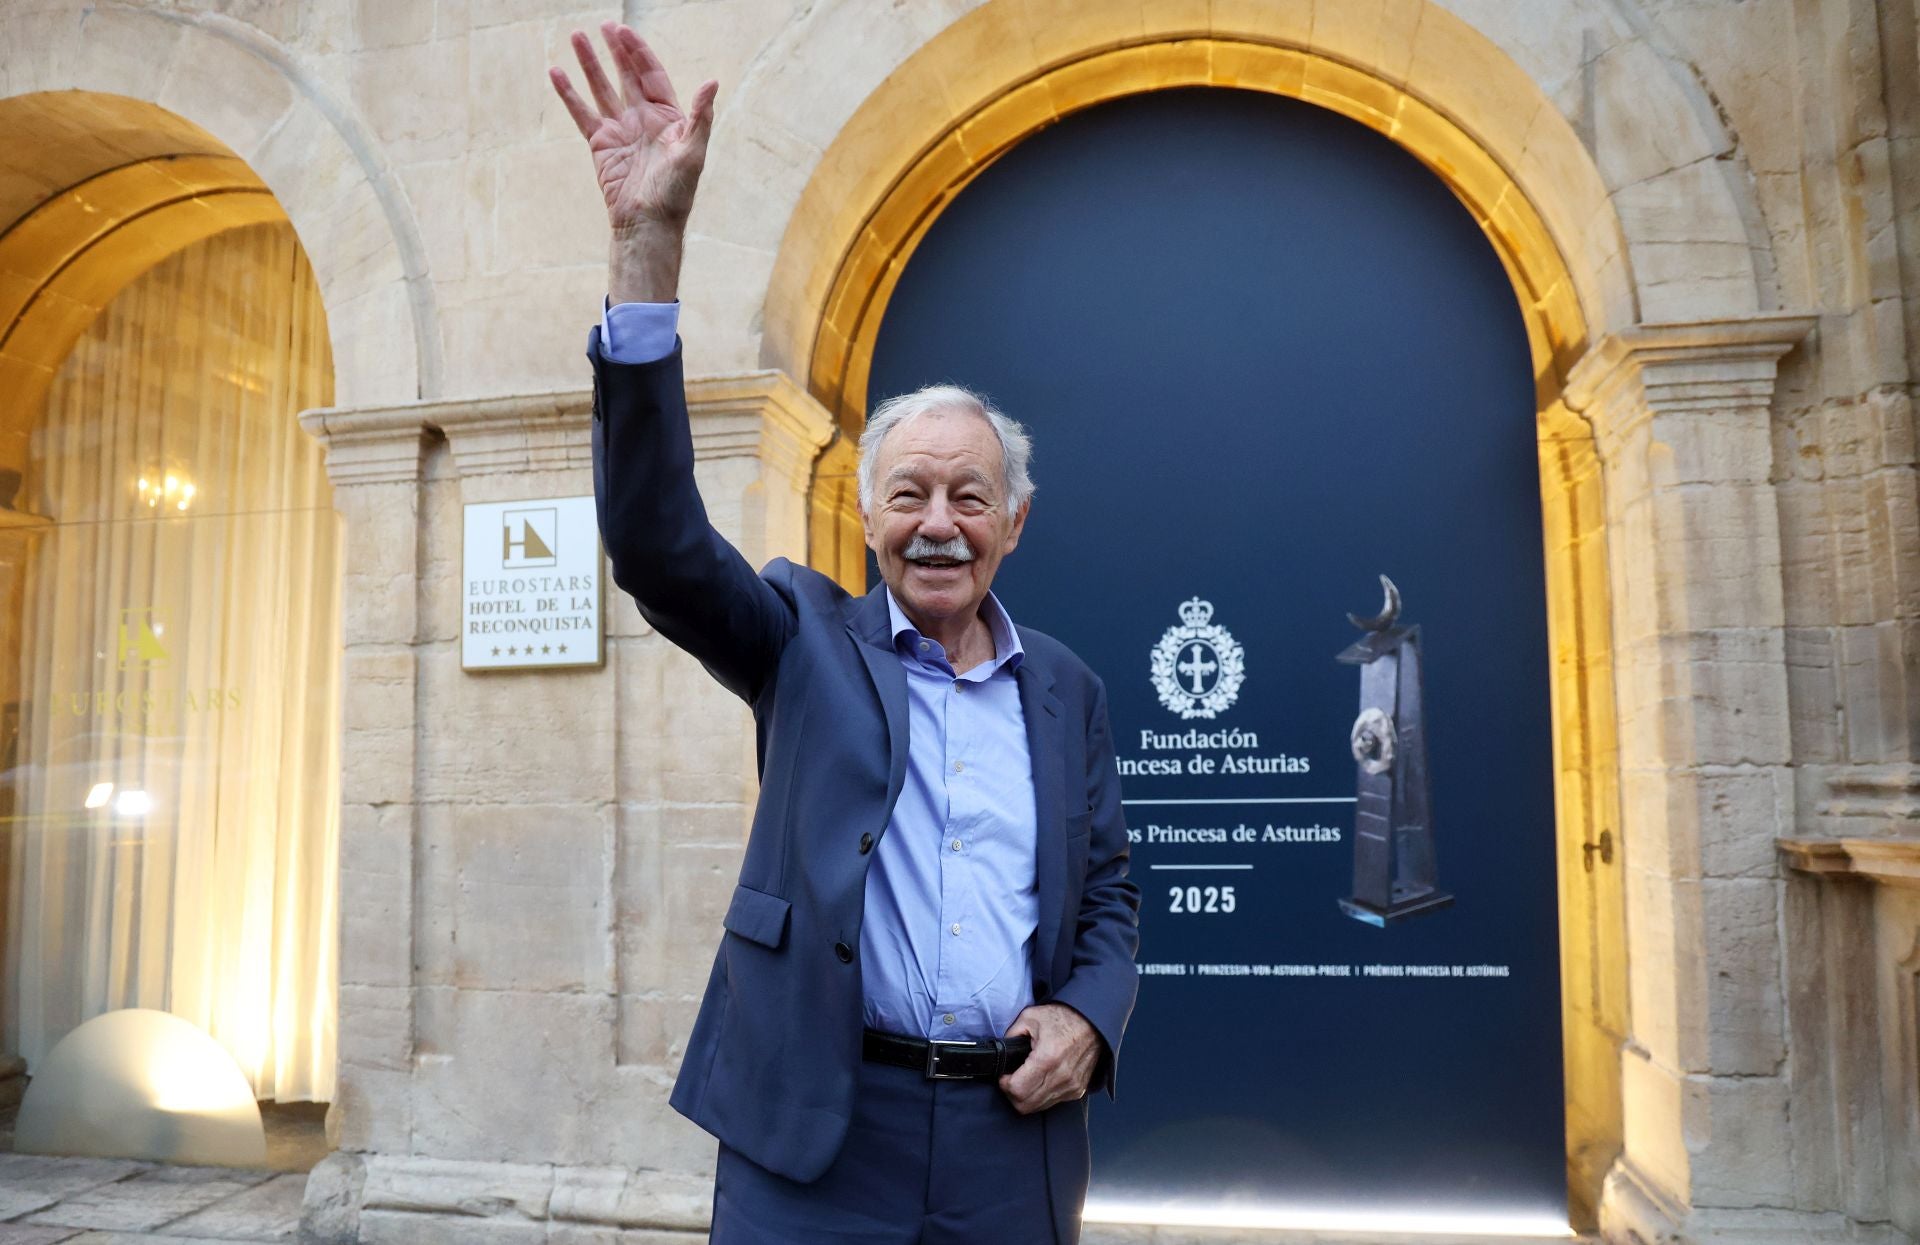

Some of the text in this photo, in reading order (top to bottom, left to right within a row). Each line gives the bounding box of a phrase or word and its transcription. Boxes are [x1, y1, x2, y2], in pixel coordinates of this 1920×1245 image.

[469, 575, 592, 596] EUROSTARS
[469, 597, 592, 615] HOTEL DE LA
[469, 616, 592, 634] RECONQUISTA
[1140, 728, 1258, 750] Fundación
[1187, 754, 1215, 774] de
[1220, 753, 1311, 774] Asturias
[1147, 824, 1227, 843] Princesa
[1232, 823, 1257, 842] de
[1262, 823, 1341, 842] Asturias
[1169, 886, 1236, 913] 2025
[1451, 965, 1465, 977] DE
